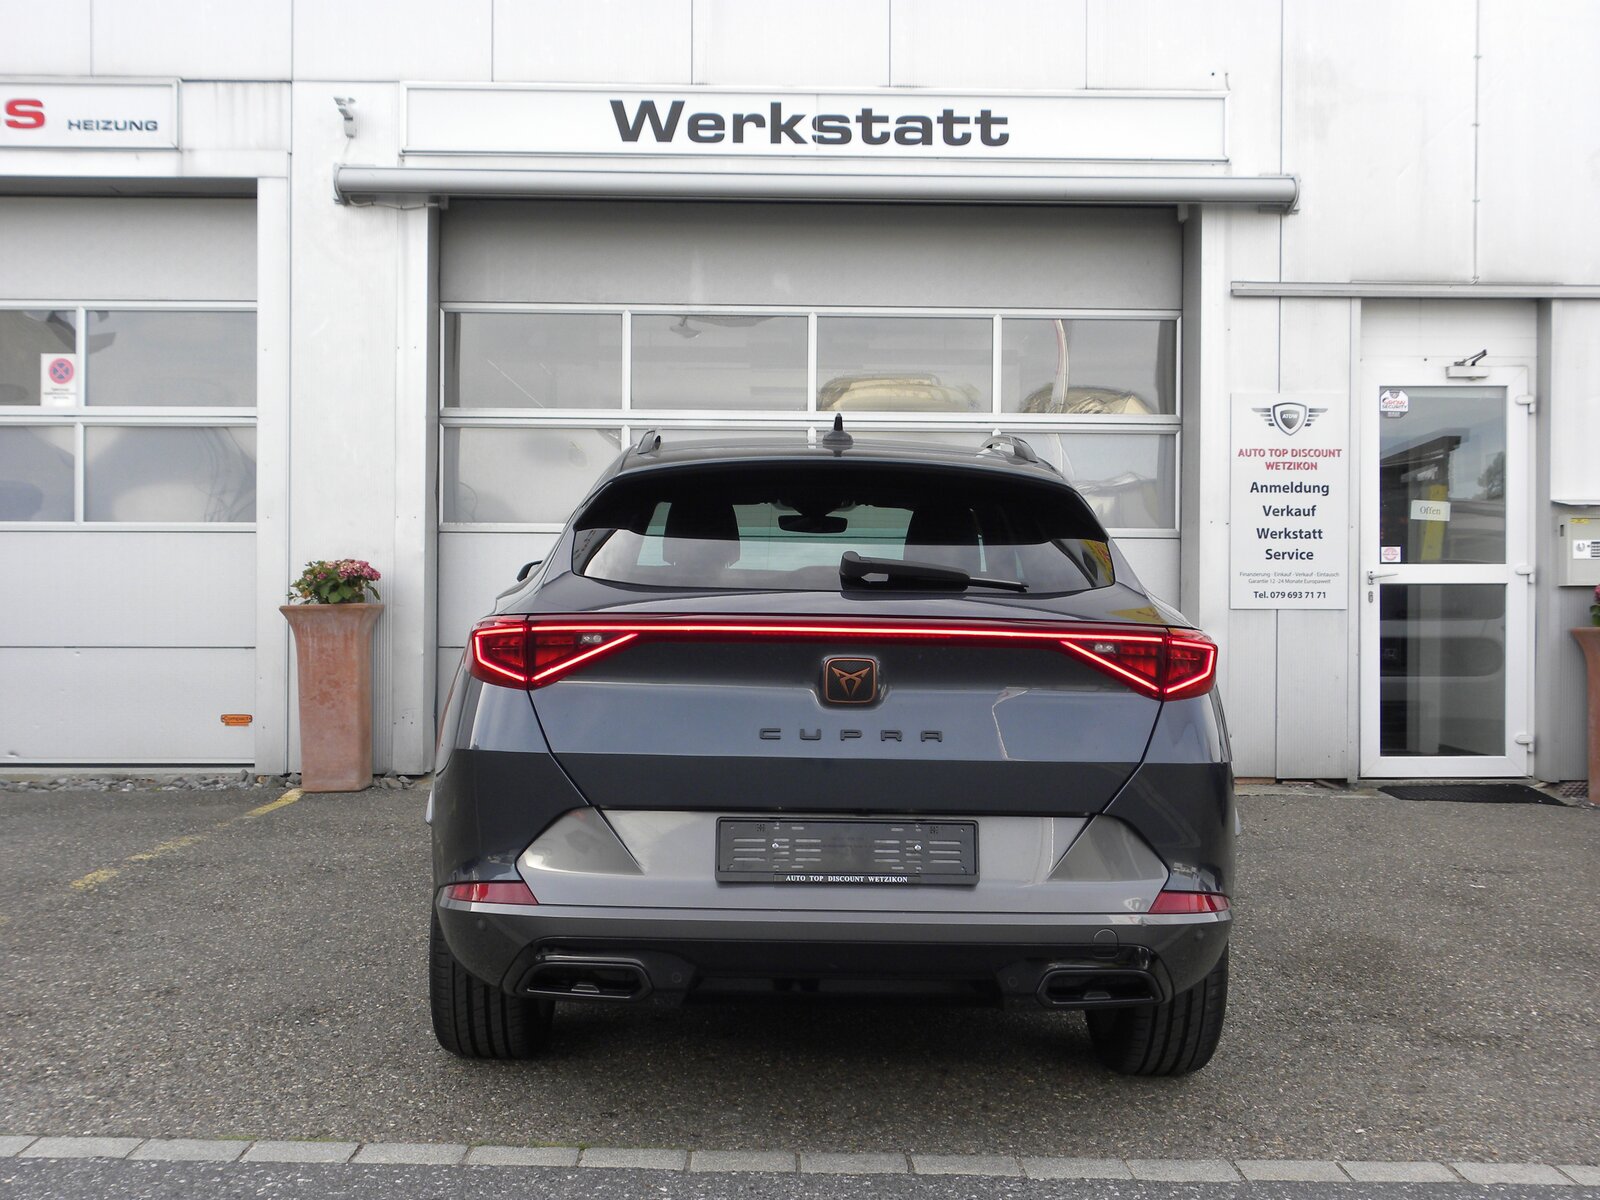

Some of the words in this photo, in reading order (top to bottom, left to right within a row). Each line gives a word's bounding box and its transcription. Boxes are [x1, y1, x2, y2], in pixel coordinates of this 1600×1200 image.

[67, 119, 158, 131] HEIZUNG
[609, 99, 1010, 147] Werkstatt
[1238, 449, 1265, 457] AUTO
[1268, 449, 1288, 457] TOP
[1291, 449, 1342, 457] DISCOUNT
[1265, 462, 1318, 470] WETZIKON
[1250, 481, 1330, 496] Anmeldung
[1262, 505, 1317, 517] Verkauf
[1419, 505, 1441, 515] Offen
[1256, 527, 1323, 539] Werkstatt
[1265, 548, 1314, 560] Service
[1253, 591, 1269, 599] Tel.
[1270, 591, 1286, 599] 079
[1287, 591, 1303, 599] 693
[1305, 591, 1314, 599] 71
[1316, 591, 1326, 599] 71
[759, 728, 943, 742] CUPRA
